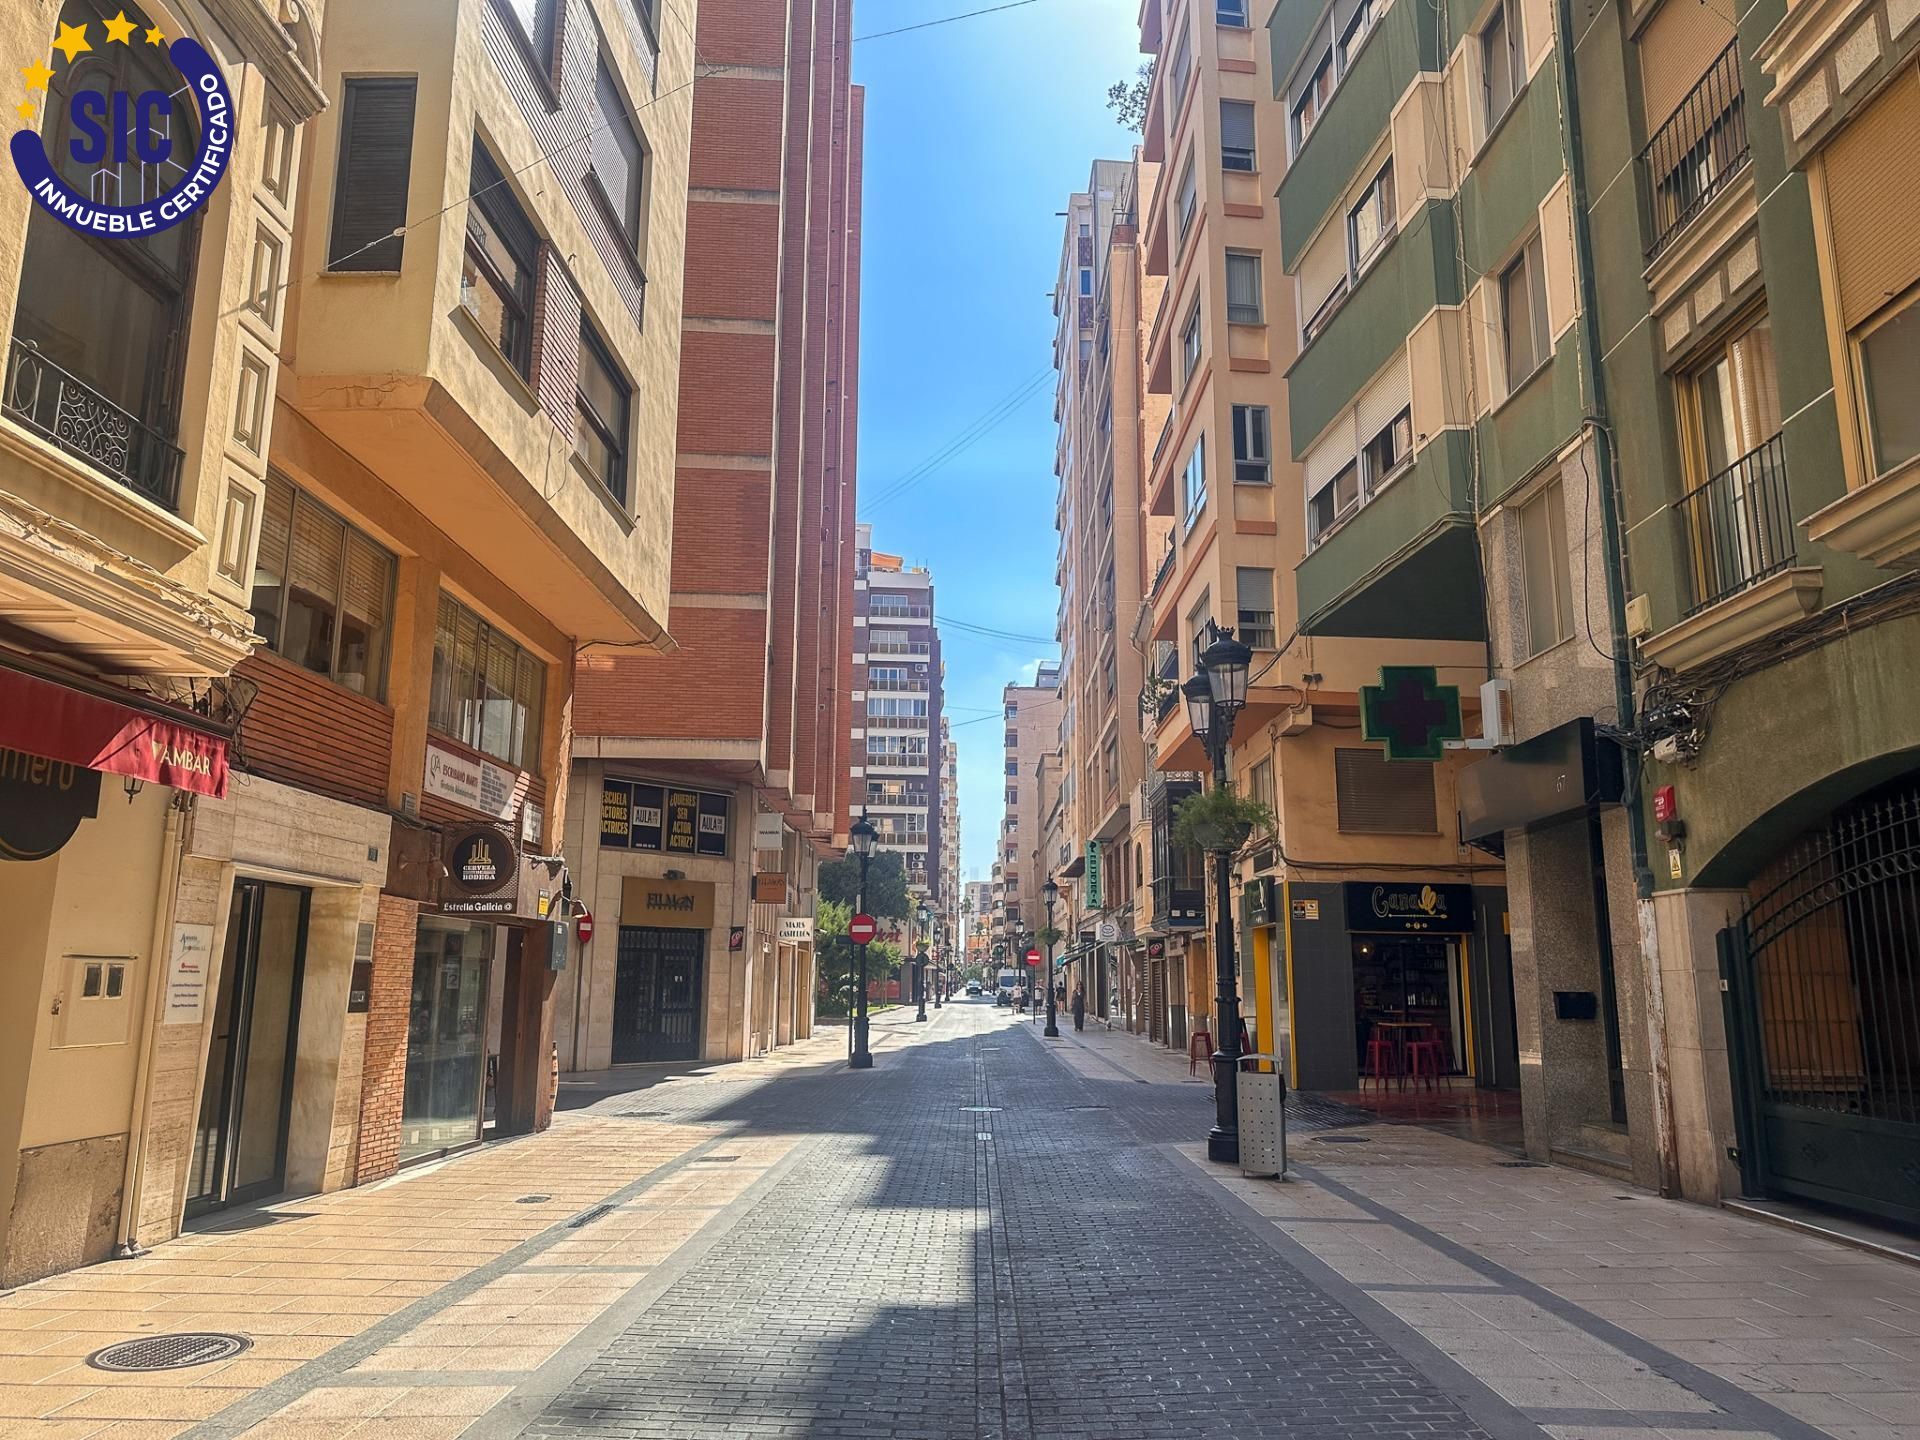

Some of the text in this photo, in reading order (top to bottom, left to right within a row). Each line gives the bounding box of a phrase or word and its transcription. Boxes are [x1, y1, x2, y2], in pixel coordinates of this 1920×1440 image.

[160, 745, 211, 777] AMBAR
[0, 750, 76, 790] mero
[601, 791, 627, 806] ESCUELA
[601, 804, 628, 820] ACTORES
[600, 819, 629, 835] ACTRICES
[462, 864, 497, 872] CERVEZA
[443, 902, 504, 912] Estrella Galicia
